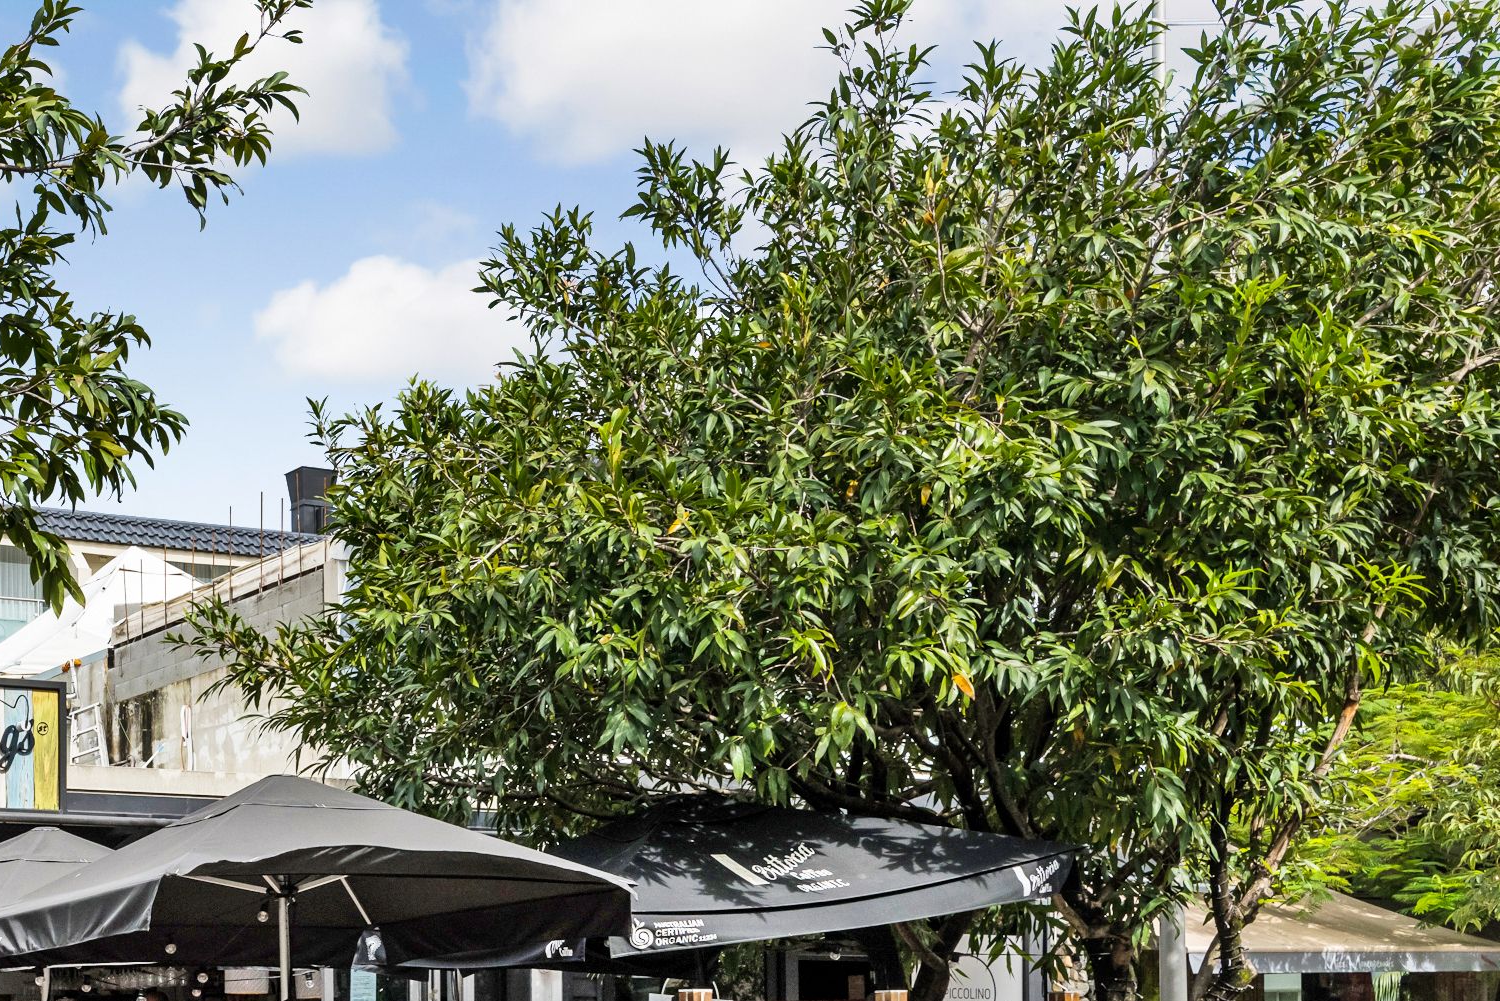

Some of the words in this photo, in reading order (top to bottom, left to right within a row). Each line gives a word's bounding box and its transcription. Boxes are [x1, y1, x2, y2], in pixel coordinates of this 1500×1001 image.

[796, 878, 851, 892] ORGANIC
[653, 919, 705, 929] AUSTRALIAN
[655, 934, 699, 946] ORGANIC
